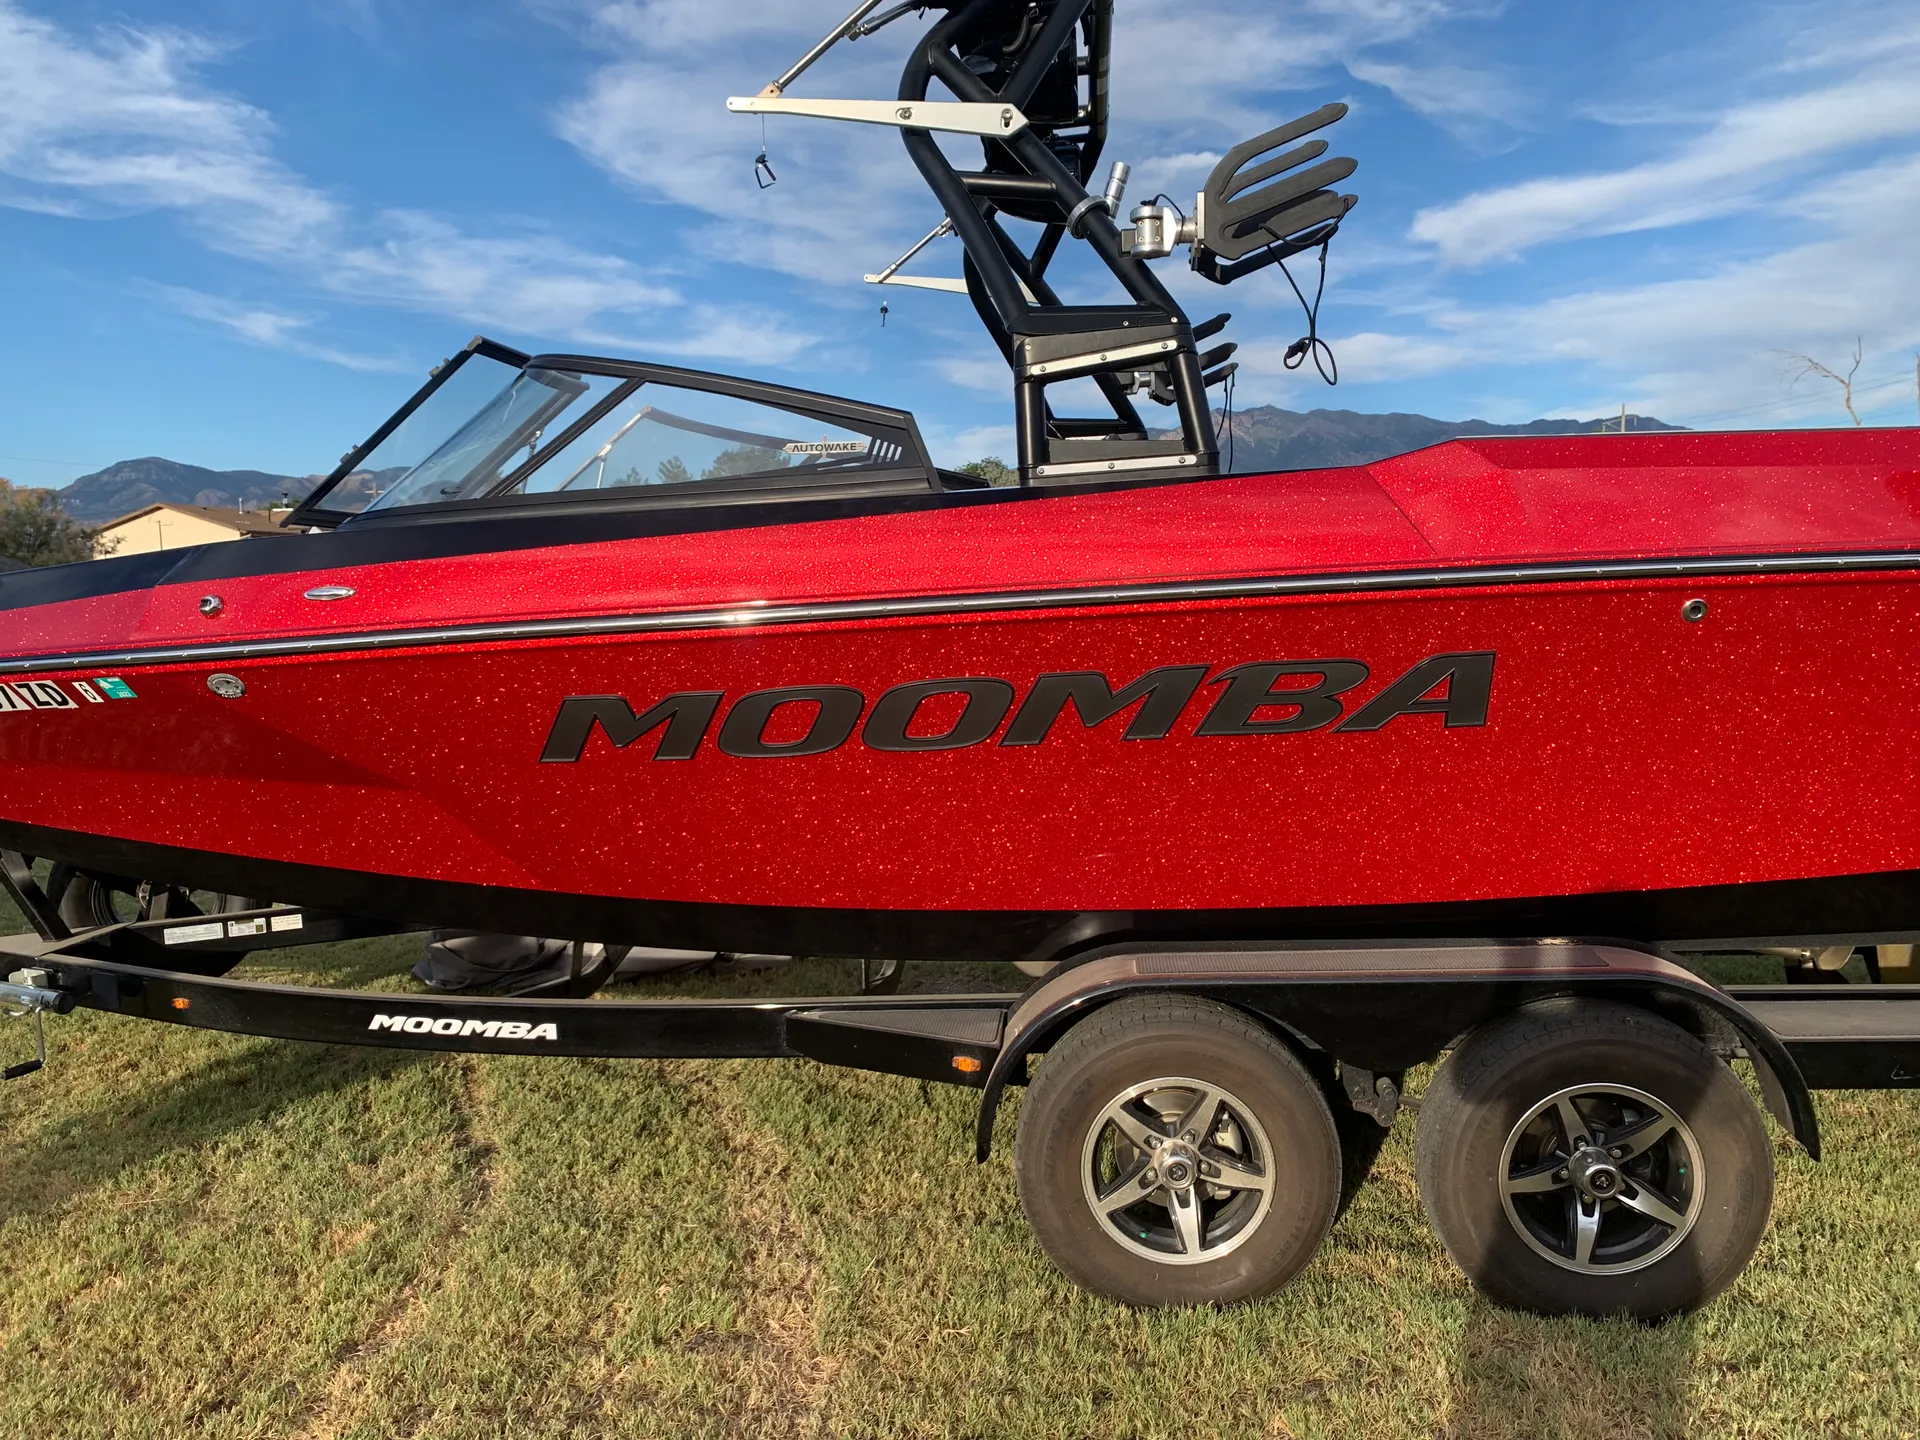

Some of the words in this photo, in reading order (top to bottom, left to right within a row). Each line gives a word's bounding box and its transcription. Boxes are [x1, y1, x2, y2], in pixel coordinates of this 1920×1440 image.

[791, 442, 857, 453] AUTOWAKE
[539, 651, 1497, 764] MOOMBA
[367, 1014, 558, 1041] MOOMBA
